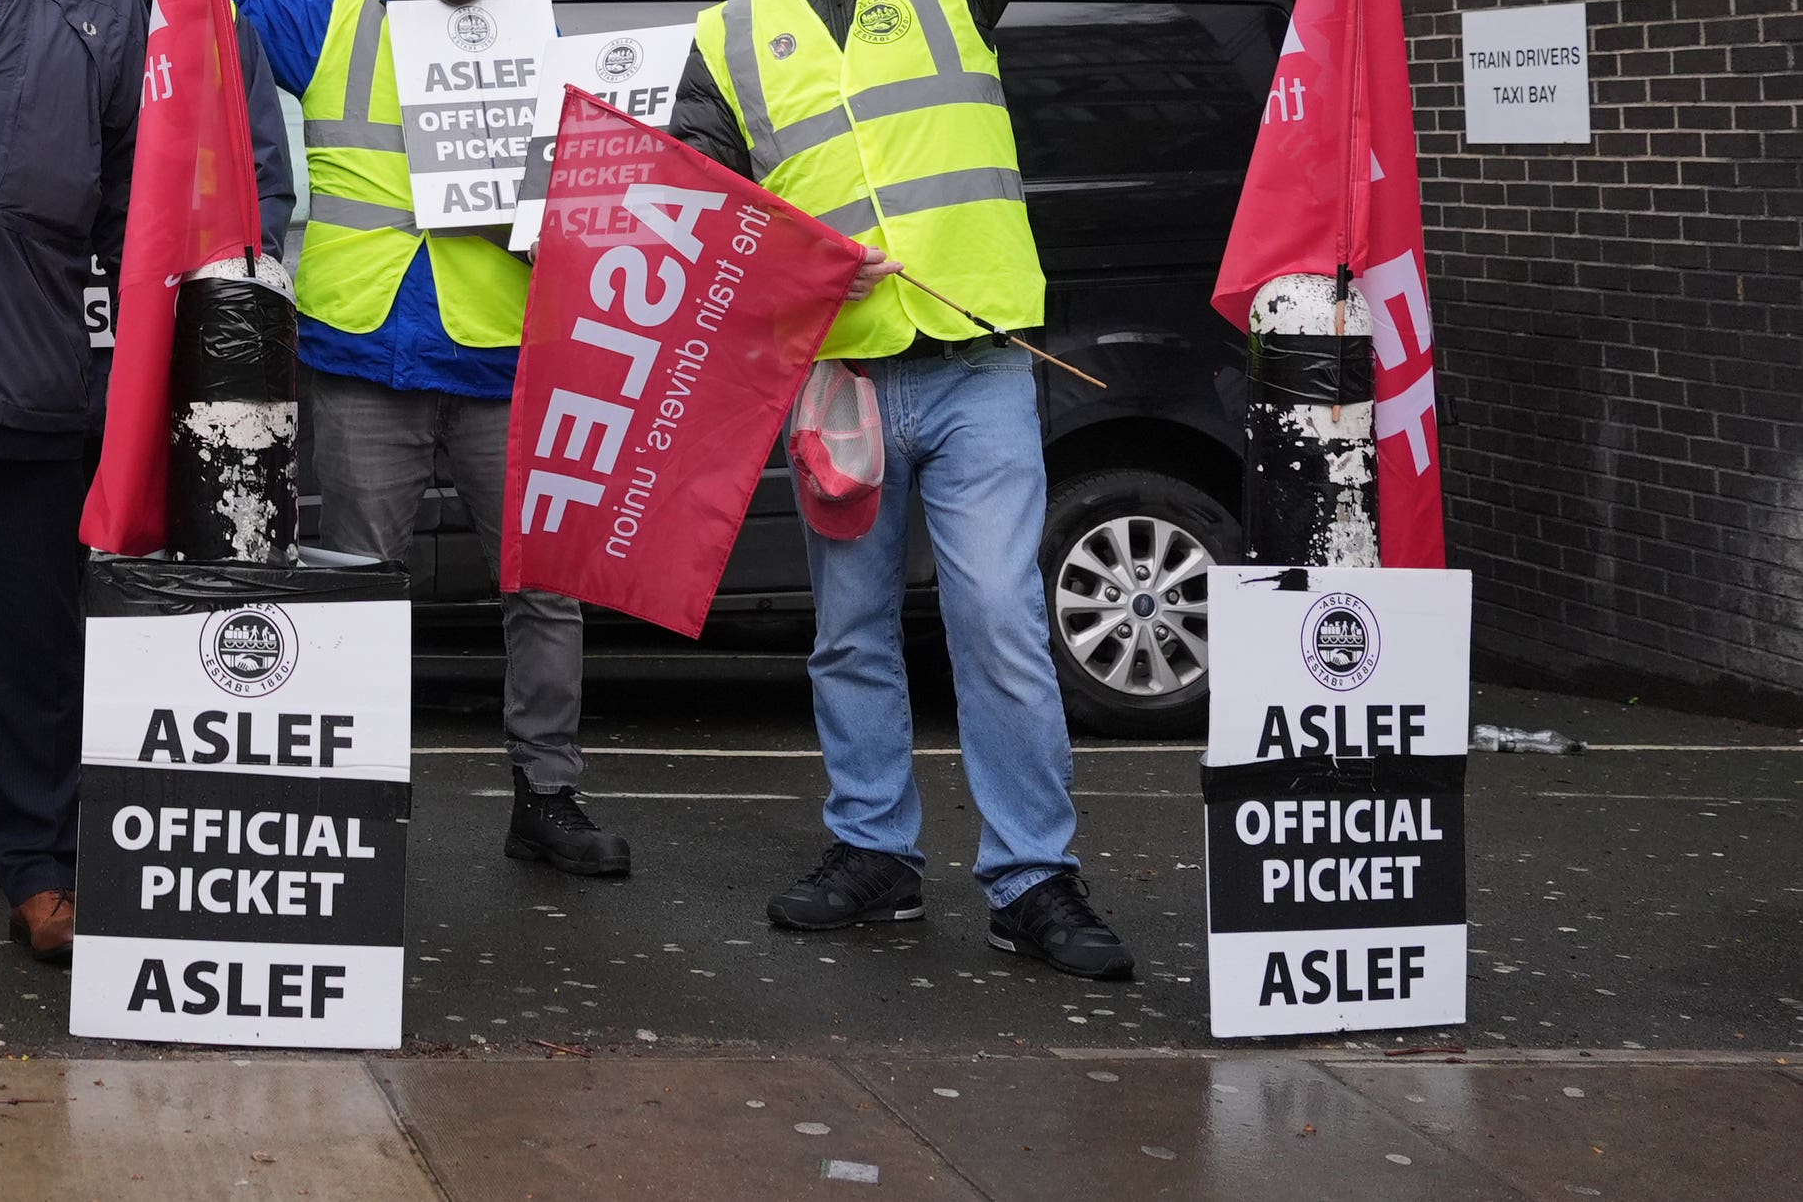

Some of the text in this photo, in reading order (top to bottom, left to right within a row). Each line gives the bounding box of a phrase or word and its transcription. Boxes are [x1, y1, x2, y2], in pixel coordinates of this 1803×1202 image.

[1469, 46, 1581, 69] TRAIN DRIVERS
[425, 58, 536, 93] ASLEF
[1493, 85, 1557, 104] TAXI BAY
[418, 105, 535, 132] OFFICIA
[550, 163, 656, 190] PICKET
[443, 179, 523, 214] ASL
[1322, 595, 1360, 610] ASLEF
[260, 665, 290, 691] 1880
[1351, 658, 1375, 684] 1880
[137, 709, 354, 768] ASLEF
[1256, 704, 1426, 758] ASLEF
[111, 804, 376, 859] OFFICIAL
[1235, 798, 1443, 846] OFFICIAL
[140, 865, 345, 917] PICKET
[1262, 855, 1421, 903] PICKET
[126, 958, 347, 1019] ASLEF
[1258, 945, 1426, 1007] ASLEF
